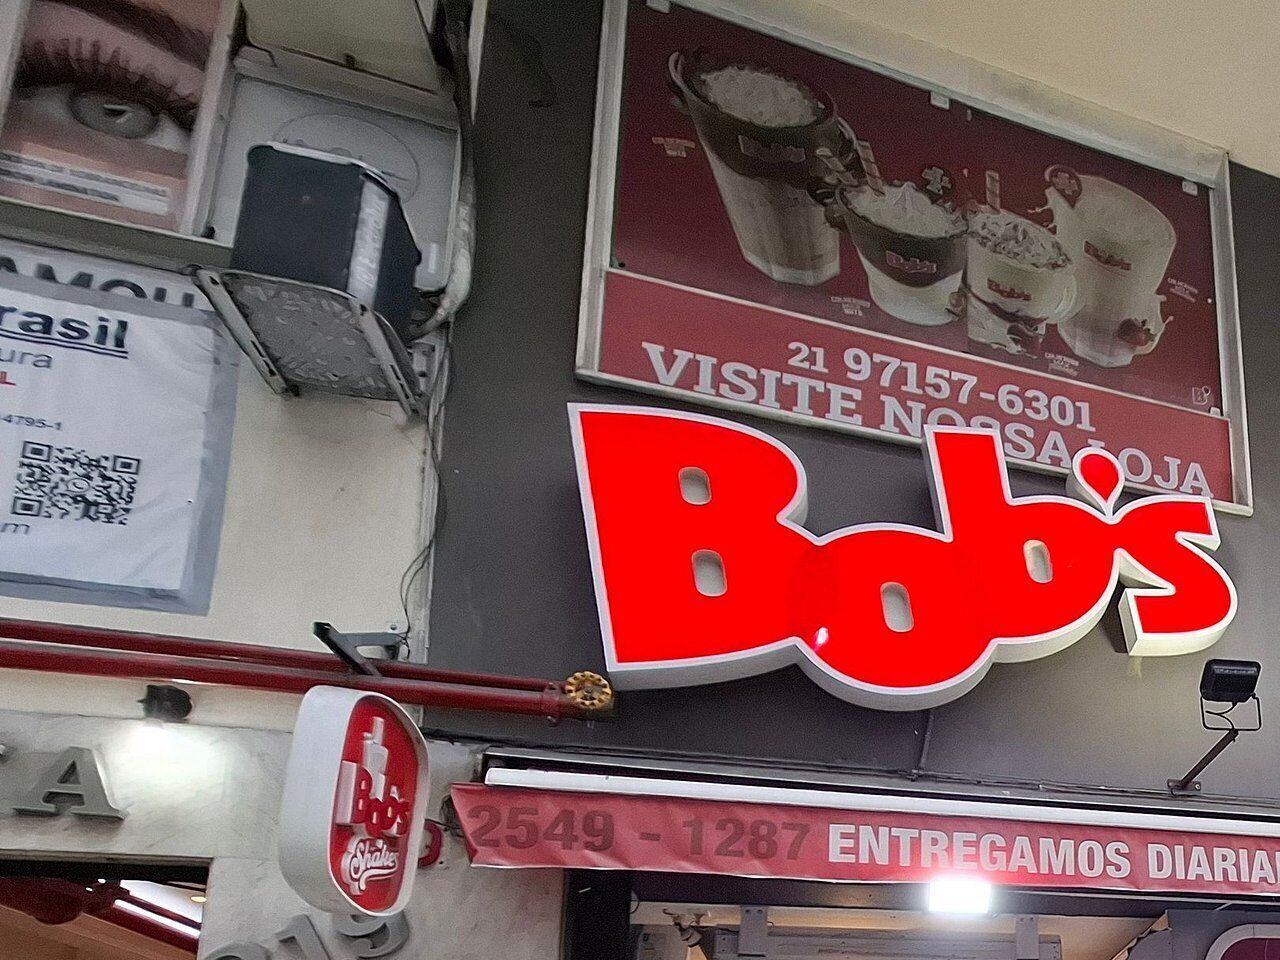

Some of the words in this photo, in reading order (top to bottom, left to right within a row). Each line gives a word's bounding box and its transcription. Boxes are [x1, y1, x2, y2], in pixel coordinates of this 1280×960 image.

[641, 342, 864, 426] VISITE
[787, 341, 828, 375] 21
[844, 348, 1096, 432] 97157-6301
[567, 402, 1238, 700] Bob's
[467, 804, 616, 852] 2549
[683, 816, 811, 862] 1287
[828, 823, 1131, 879] ENTREGAMOS
